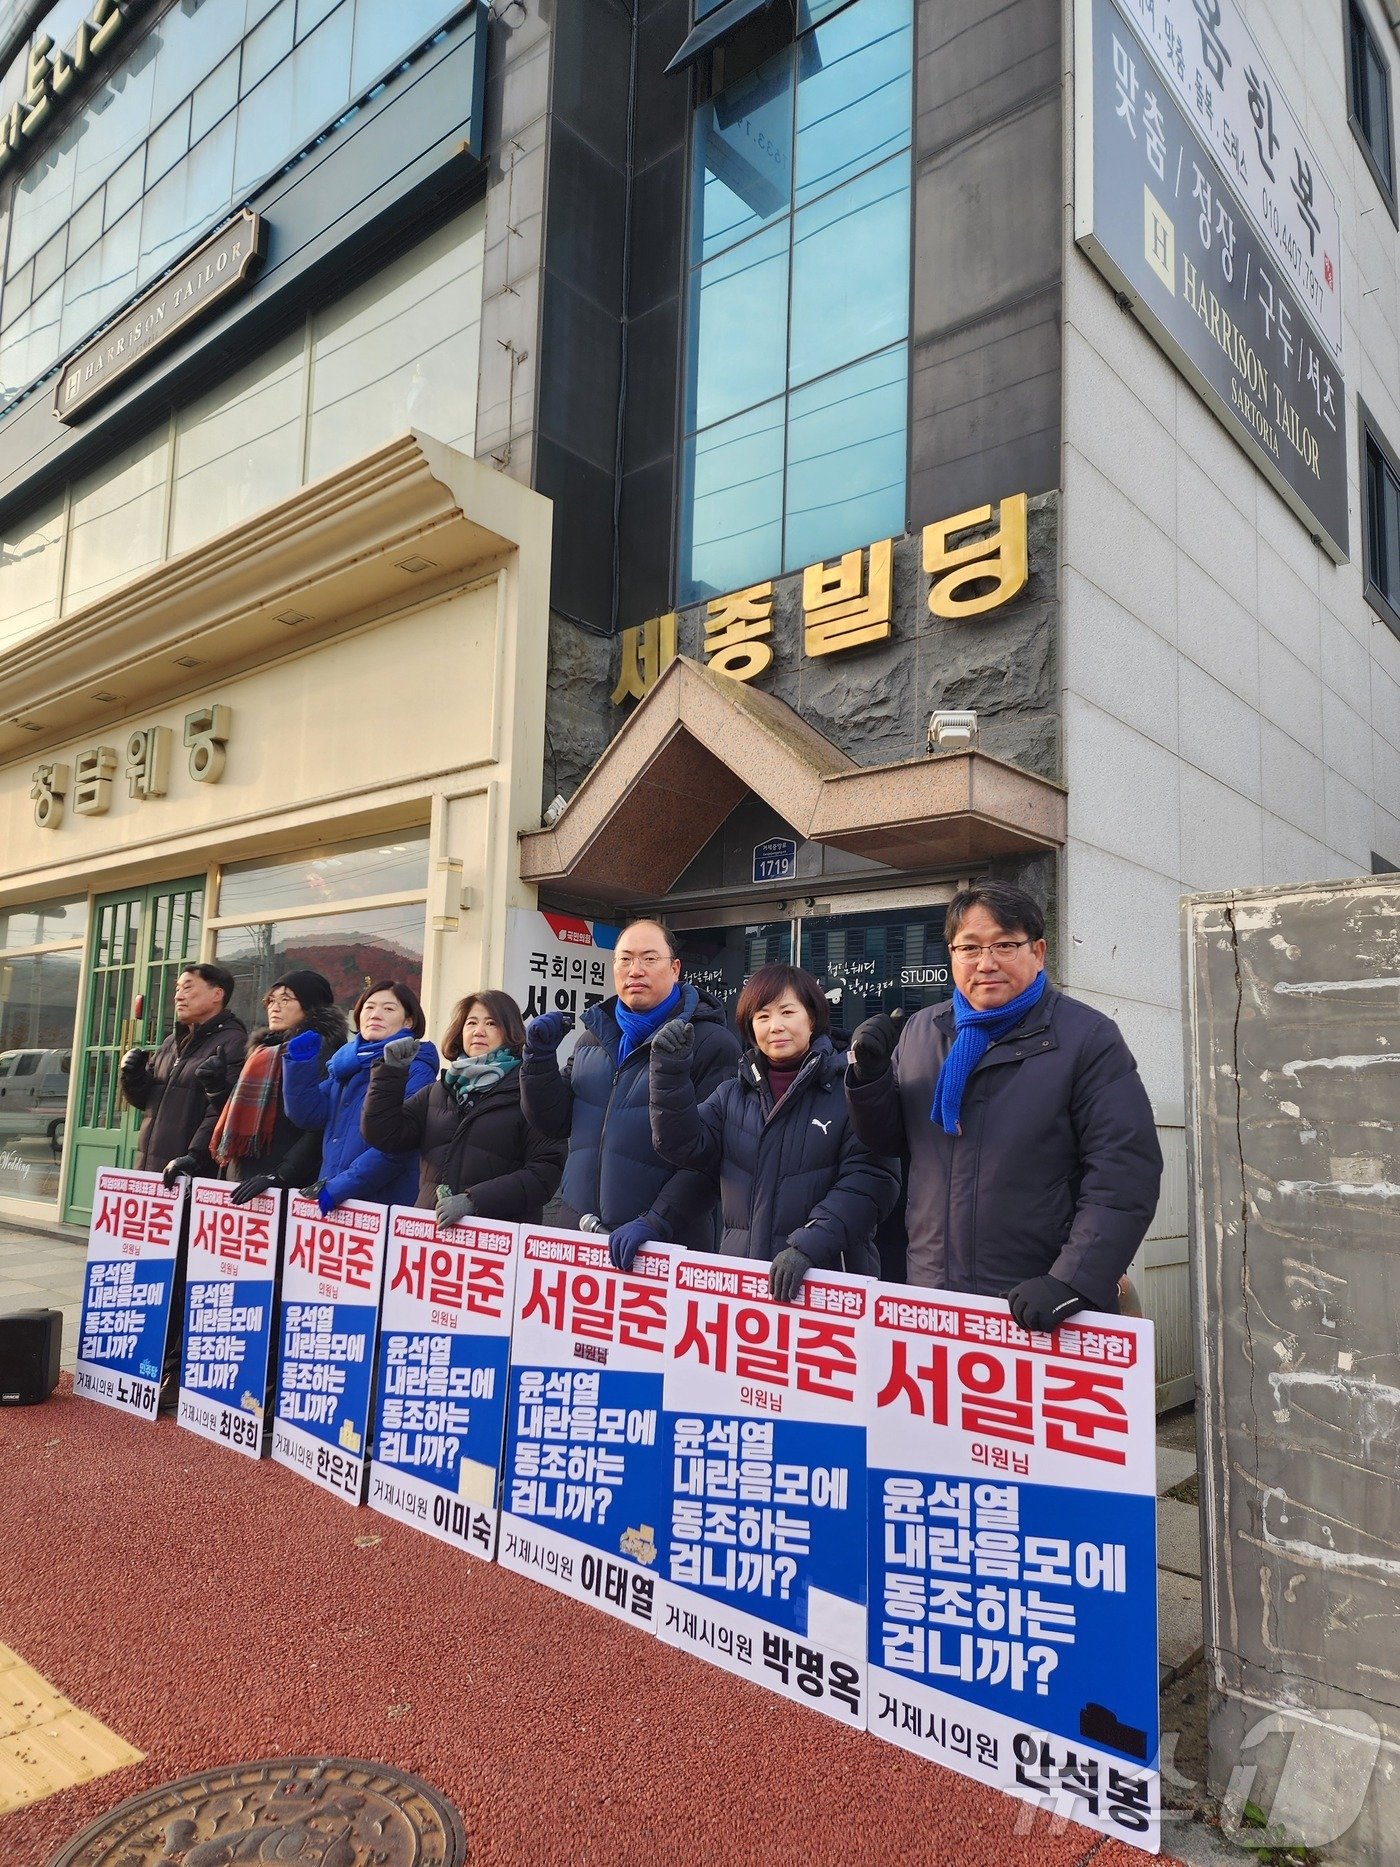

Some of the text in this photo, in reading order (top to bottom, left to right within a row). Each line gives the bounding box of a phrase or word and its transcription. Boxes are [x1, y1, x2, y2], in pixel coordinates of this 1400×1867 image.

[1112, 33, 1336, 431] 맞춤 정장 구두 셔츠
[85, 303, 167, 382] HARRISON
[173, 242, 241, 308] TAILOR
[1183, 253, 1268, 408] HARRISON
[1273, 383, 1321, 480] TAILOR
[1231, 377, 1279, 459] SARTORIA
[611, 492, 1028, 706] 세종빌딩
[30, 704, 232, 829] 청담웨딩
[760, 858, 789, 876] 1719
[567, 931, 591, 943] 국민의힘
[530, 952, 605, 986] 국회의원
[900, 968, 948, 984] STUDIO
[95, 1196, 174, 1246] 서일준
[193, 1210, 271, 1266] 서일준
[395, 1218, 435, 1240] 계엄해제
[477, 1231, 511, 1254] 불참한
[219, 1261, 239, 1277] 의원님
[289, 1223, 375, 1290] 서일준
[527, 1239, 575, 1263] 계엄해제
[88, 1282, 164, 1307] 내란음모에
[90, 1262, 136, 1287] 윤석열
[190, 1282, 235, 1309] 윤석열
[318, 1282, 339, 1299] 의원님
[391, 1245, 505, 1318] 서일준
[679, 1266, 738, 1295] 계엄해제
[809, 1285, 862, 1316] 불참한
[85, 1310, 146, 1334] 동조하는
[189, 1306, 263, 1334] 내란음모에
[285, 1305, 335, 1333] 윤석열
[431, 1310, 458, 1328] 의원님
[521, 1268, 667, 1353] 서일준
[878, 1300, 959, 1336] 계엄해제
[1059, 1327, 1132, 1362] 불참한
[82, 1335, 138, 1360] 겁니까?
[186, 1335, 246, 1362] 동조하는
[284, 1332, 365, 1363] 내란음모에
[386, 1336, 452, 1367] 윤석열
[573, 1342, 609, 1366] 의원님
[674, 1300, 857, 1402] 서일준
[77, 1371, 156, 1413] 거제시의원 노재하
[184, 1363, 239, 1390] 겁니까?
[281, 1362, 346, 1394] 동조하는
[385, 1366, 495, 1400] 내란음모에
[519, 1371, 600, 1406] 윤석열
[279, 1391, 338, 1426] 겁니까?
[382, 1398, 470, 1435] 동조하는
[740, 1386, 782, 1413] 의원님
[877, 1339, 1129, 1467] 서일준
[181, 1401, 259, 1451] 거제시의원 최양희
[517, 1405, 657, 1446] 내란음모에
[674, 1418, 774, 1461] 윤석열
[274, 1433, 358, 1496] 거제시의원 한은진
[379, 1431, 460, 1469] 겁니까?
[514, 1442, 625, 1486] 동조하는
[971, 1442, 1029, 1476] 의원님
[511, 1478, 613, 1525] 겁니까?
[674, 1457, 849, 1510] 내란음모에
[883, 1477, 1020, 1532] 윤석열
[373, 1479, 492, 1551] 거제시의원 이미숙
[672, 1499, 810, 1555] 동조하는
[505, 1532, 655, 1621] 거제시의원 이태열
[669, 1541, 797, 1600] 겁니까?
[884, 1523, 1126, 1593] 내란음모에
[883, 1571, 1076, 1644] 동조하는
[665, 1603, 861, 1716] 거제시의원 박명옥
[882, 1621, 1059, 1696] 겁니까?
[878, 1692, 1152, 1833] 거제시의원 안석봉
